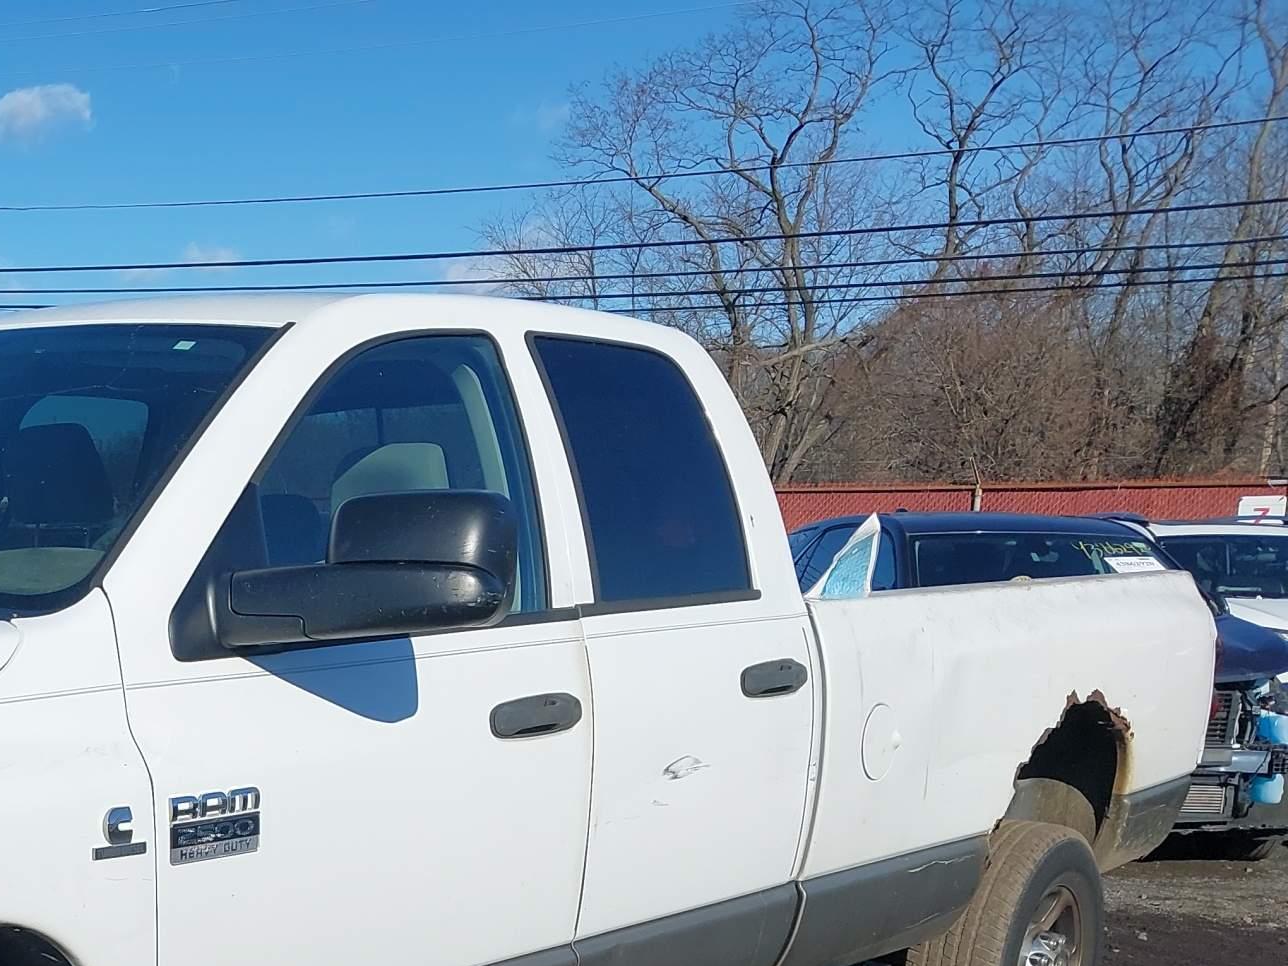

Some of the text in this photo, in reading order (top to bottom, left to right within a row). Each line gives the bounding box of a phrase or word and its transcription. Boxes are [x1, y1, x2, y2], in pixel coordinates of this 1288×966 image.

[169, 787, 260, 824] RAM
[180, 837, 251, 861] HEAVY DUTY
